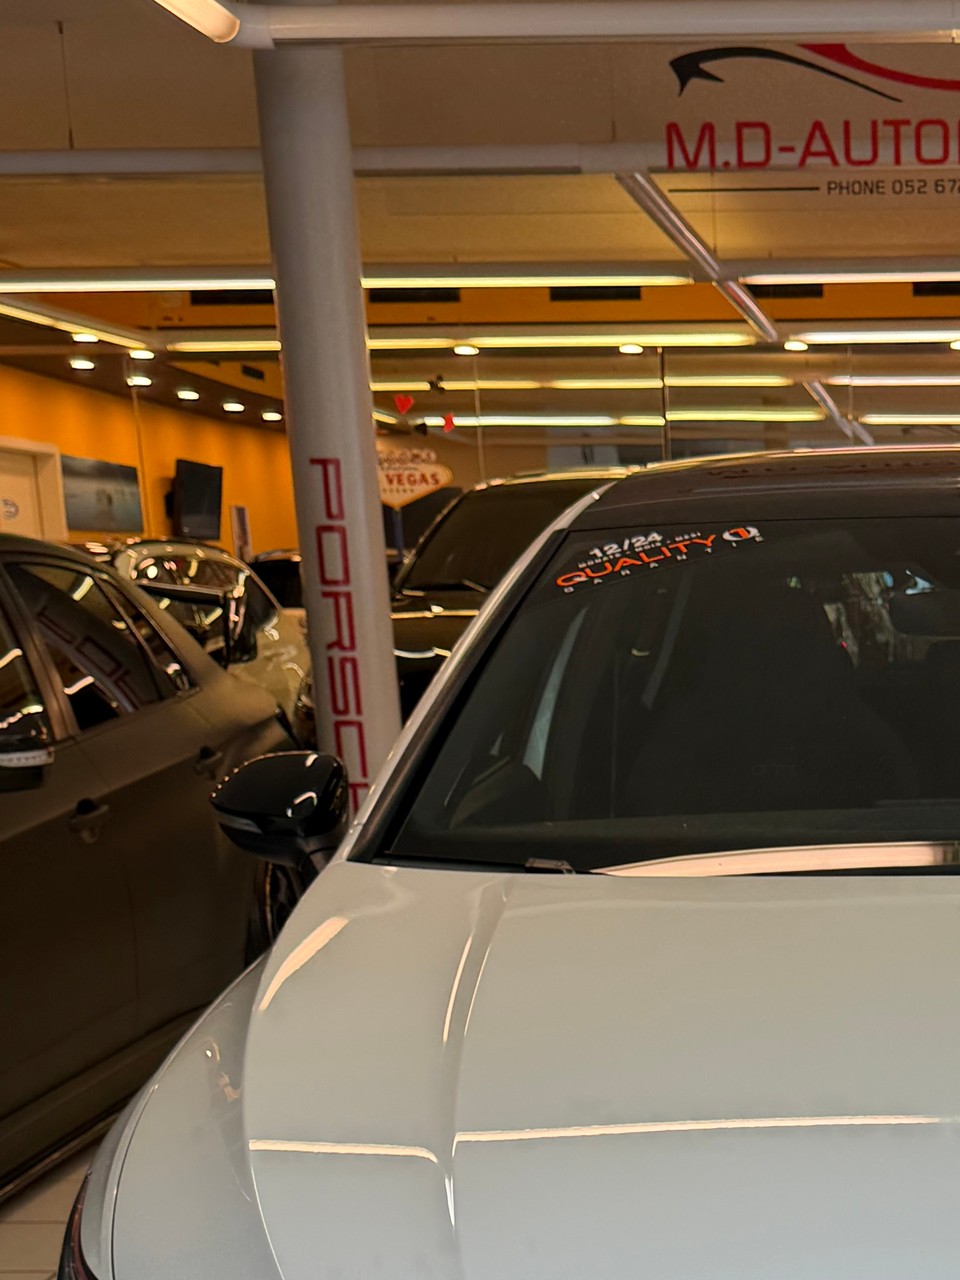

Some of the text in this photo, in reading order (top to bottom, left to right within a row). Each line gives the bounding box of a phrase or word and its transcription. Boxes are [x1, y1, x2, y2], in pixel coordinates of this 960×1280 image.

[827, 180, 885, 195] PHONE
[892, 179, 927, 194] 052
[385, 472, 440, 486] VEGAS
[589, 531, 664, 558] 12/24
[556, 534, 717, 587] QUALITY
